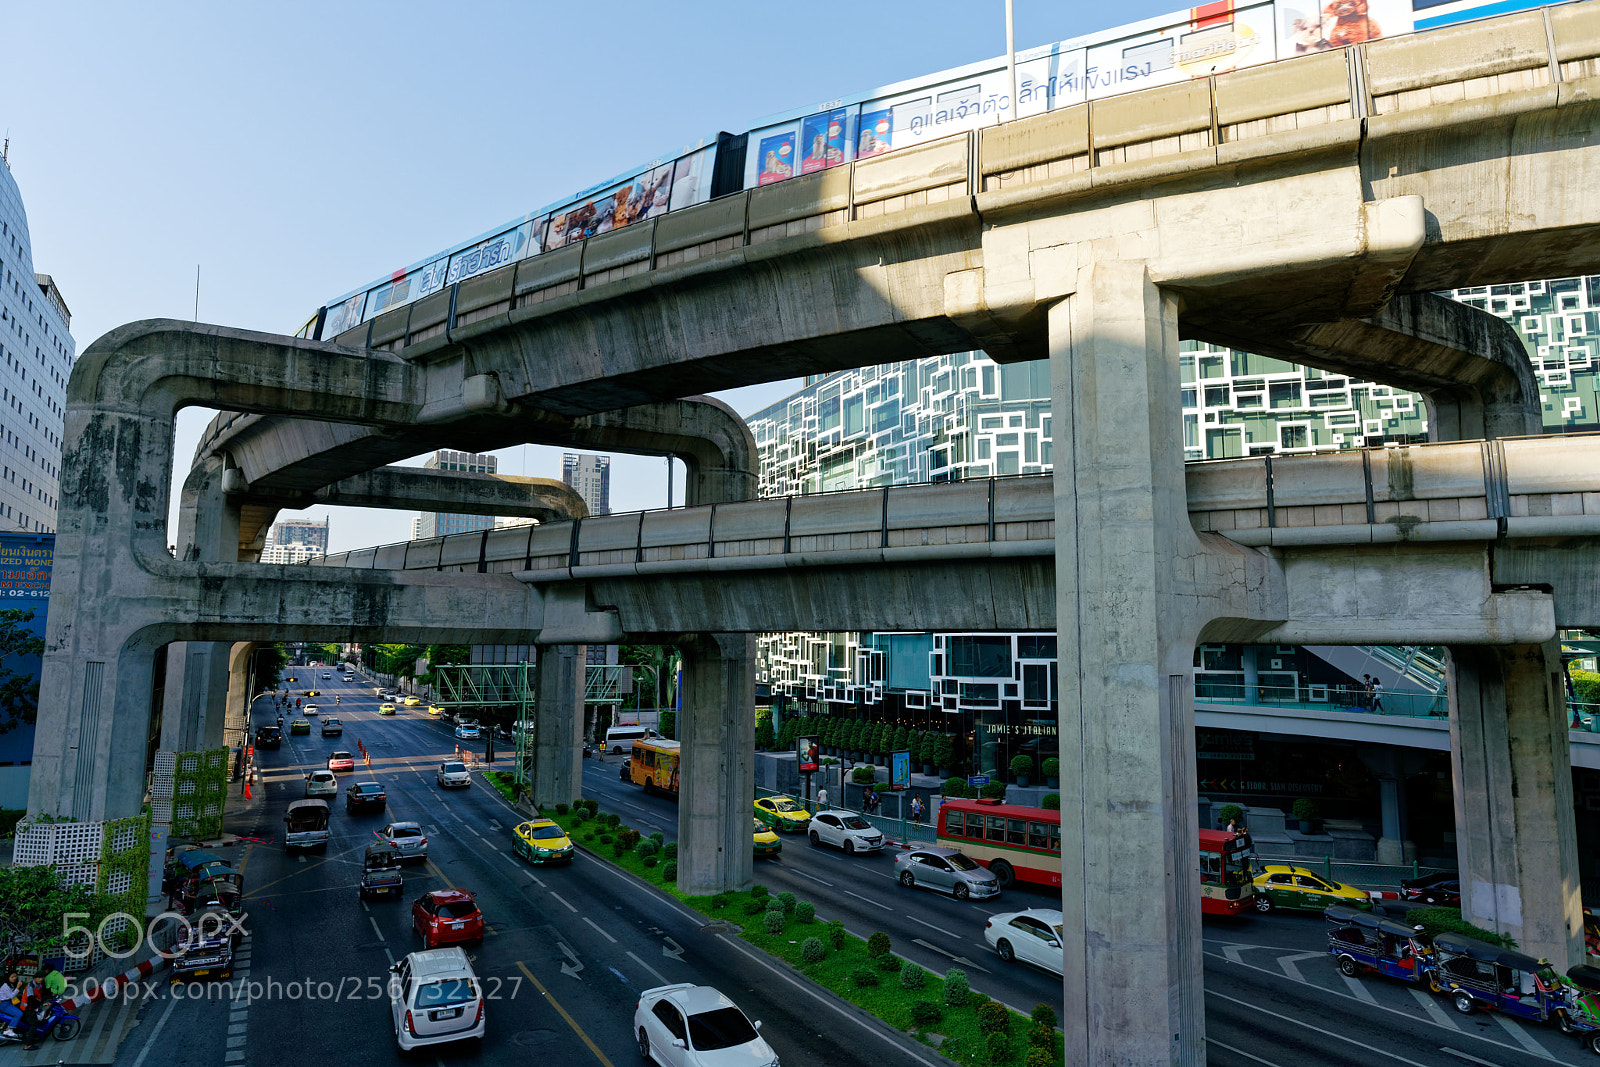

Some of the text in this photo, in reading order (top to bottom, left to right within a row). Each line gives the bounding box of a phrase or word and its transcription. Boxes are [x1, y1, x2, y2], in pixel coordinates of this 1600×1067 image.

[910, 61, 1152, 136] ดูแลเจ้าตัวล็กให้แข็งแรง
[986, 725, 1057, 736] JAMIE'S ITALIAN
